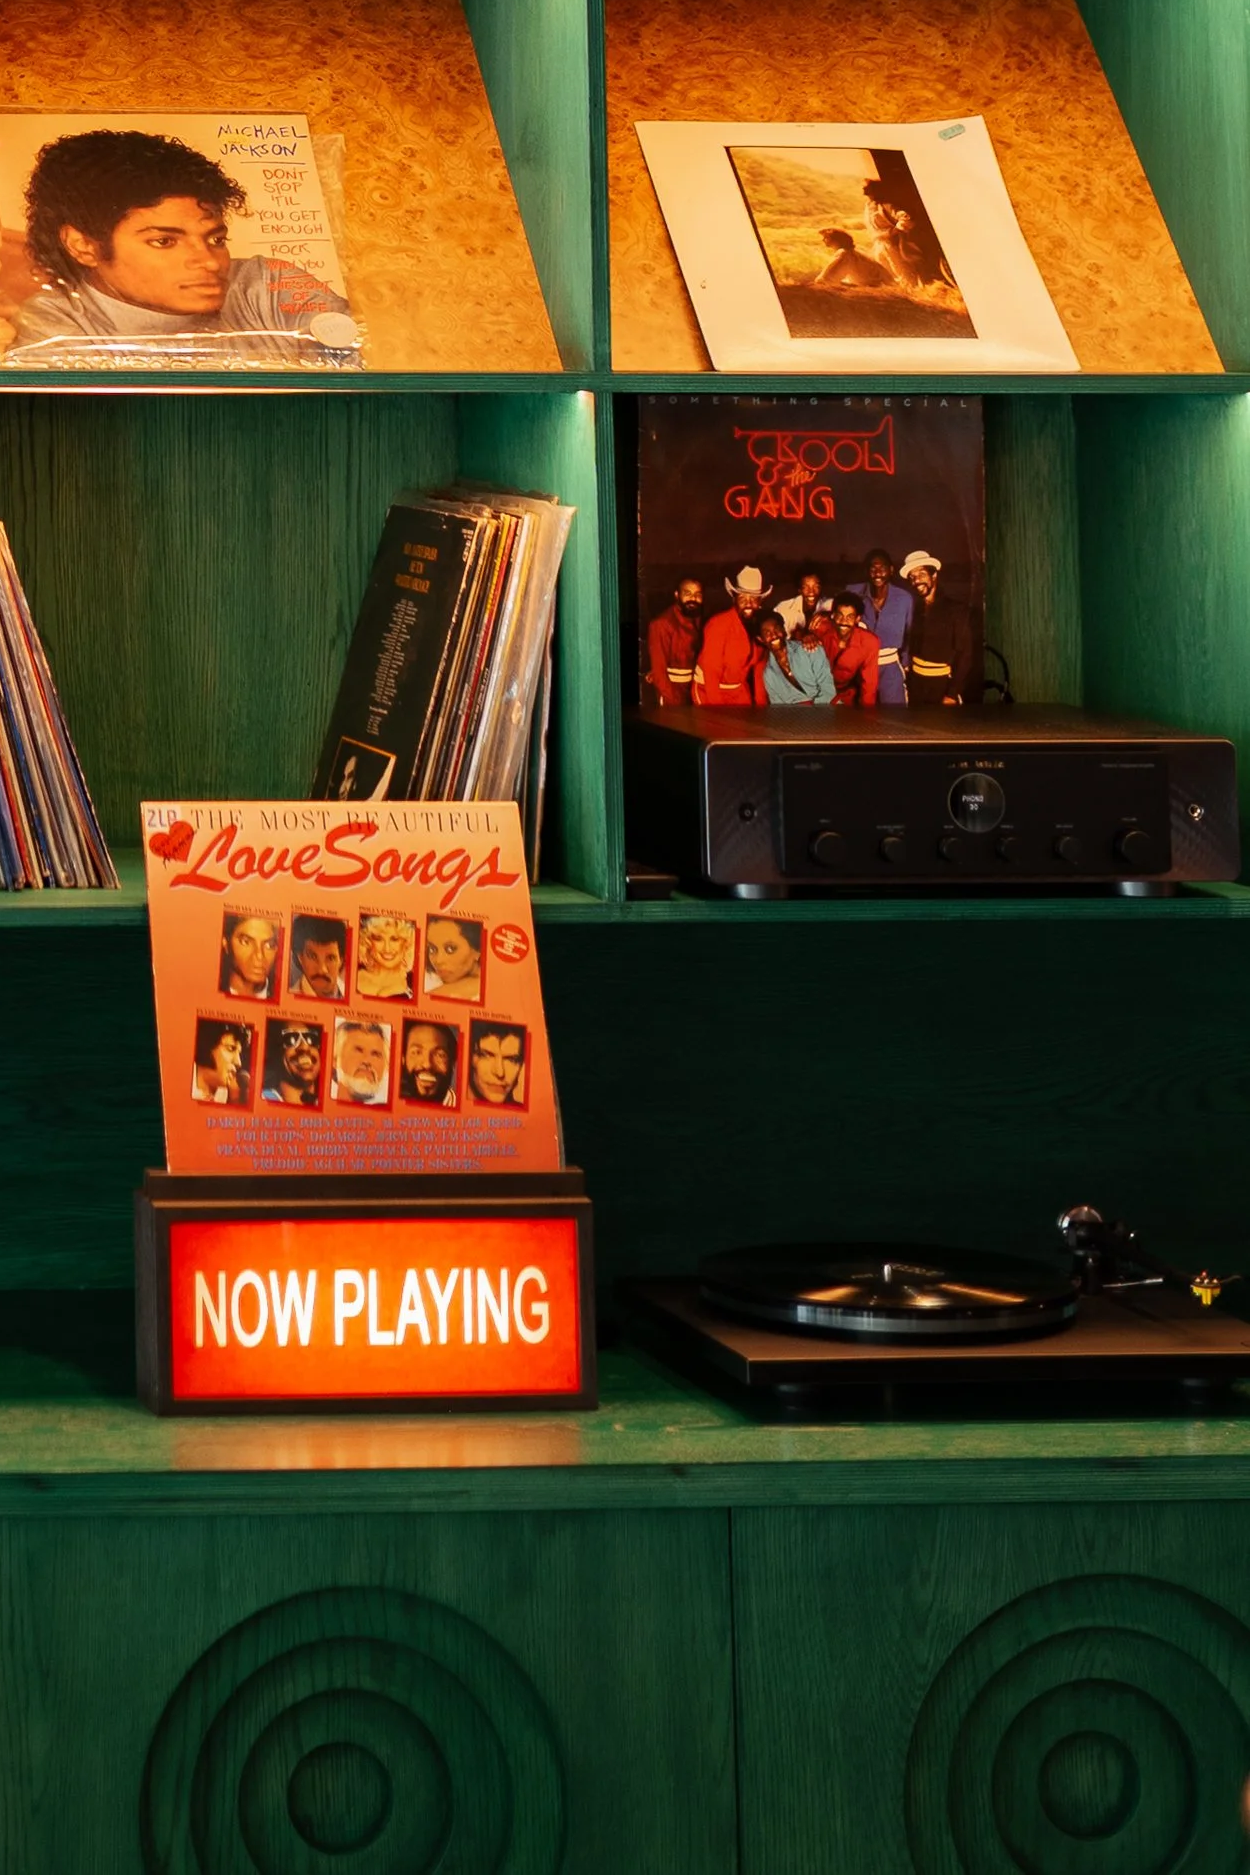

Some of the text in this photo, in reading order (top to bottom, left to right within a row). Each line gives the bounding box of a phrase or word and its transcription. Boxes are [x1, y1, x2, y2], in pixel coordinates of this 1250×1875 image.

[218, 125, 308, 139] MICHAEL
[220, 143, 297, 157] JACKSON
[263, 182, 303, 194] STOP
[256, 210, 321, 222] YOU GET
[261, 224, 323, 234] ENOUGH
[271, 243, 310, 256] ROCK
[298, 258, 325, 273] YOU
[292, 291, 310, 301] OF
[648, 395, 967, 408] SOMETHING SPECIAL
[785, 462, 816, 487] the
[724, 485, 835, 520] GANG
[191, 809, 500, 834] THE MOST BEAUTIFUL
[170, 822, 325, 893] Love
[315, 820, 521, 910] Songs
[194, 1265, 550, 1347] NOW PLAYING
